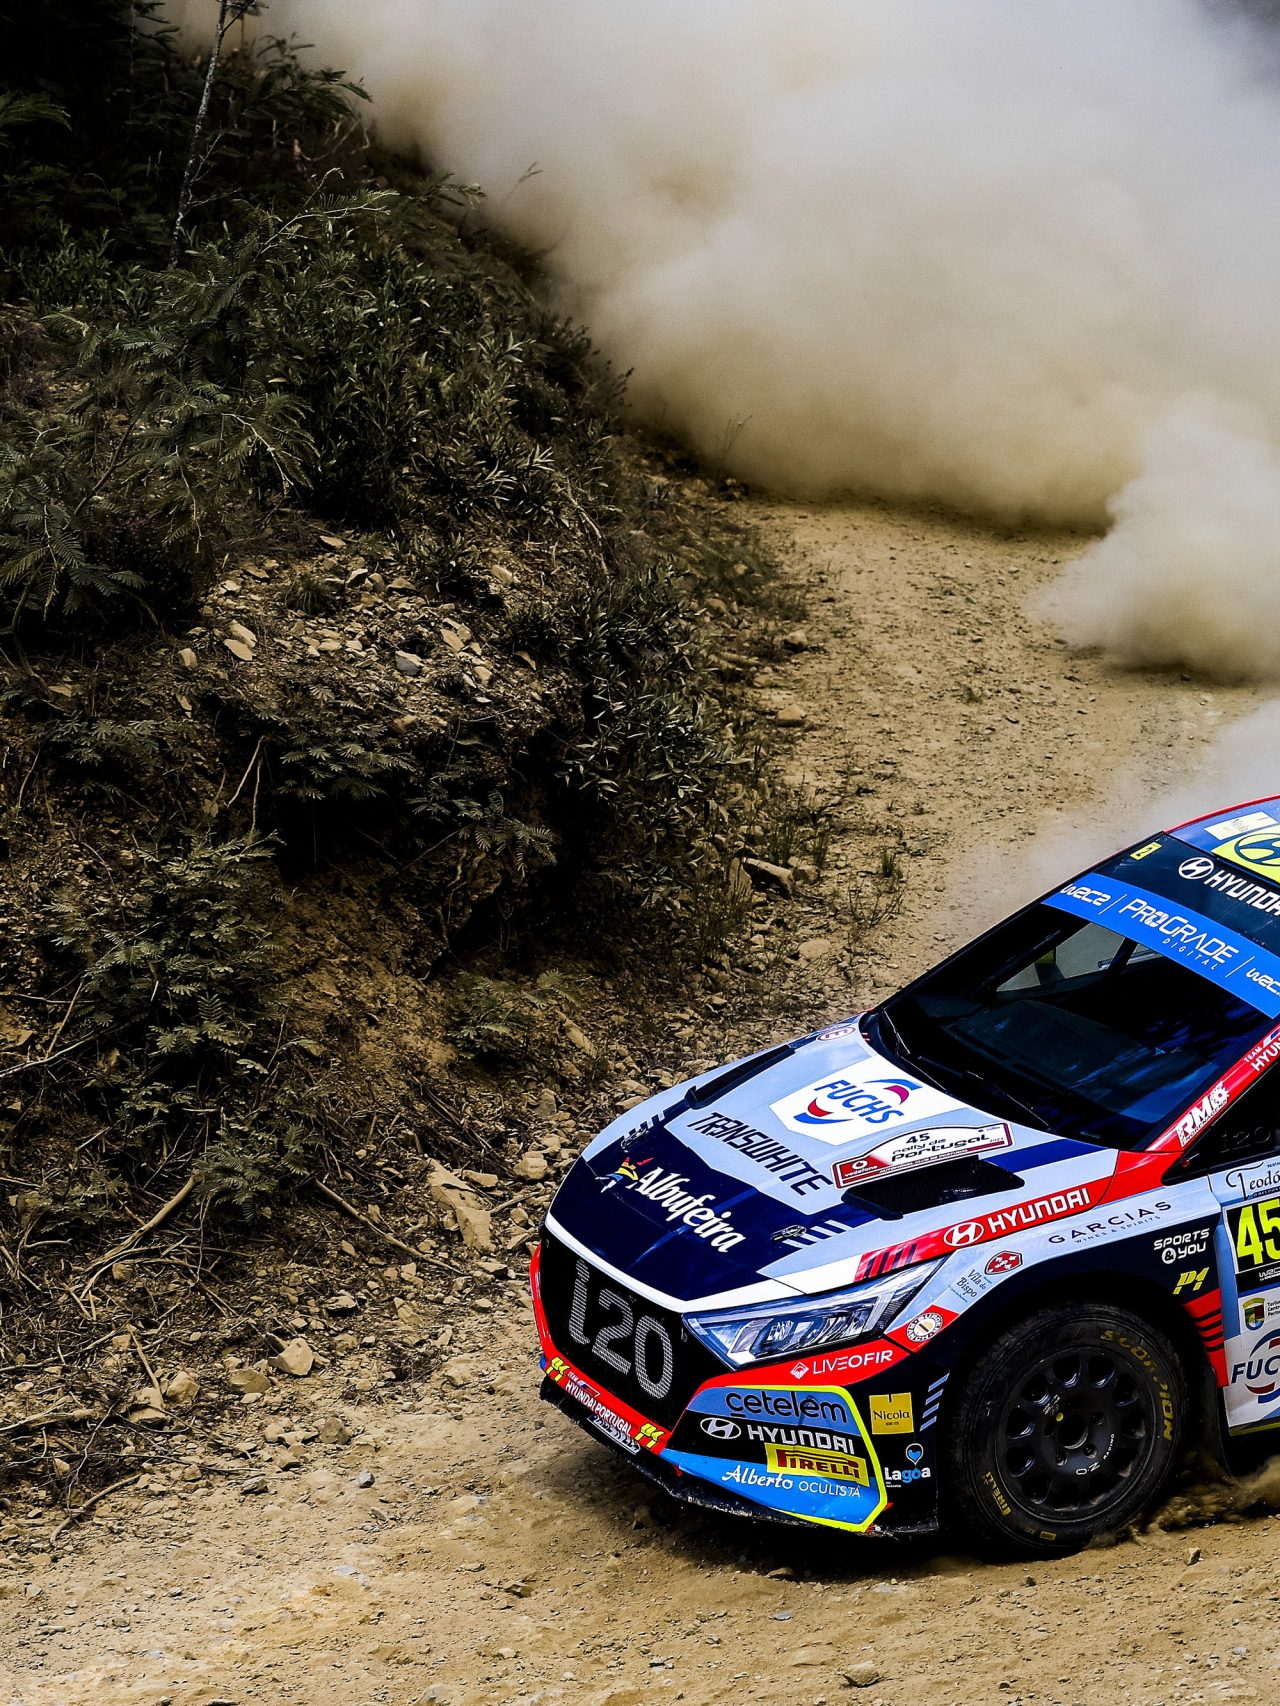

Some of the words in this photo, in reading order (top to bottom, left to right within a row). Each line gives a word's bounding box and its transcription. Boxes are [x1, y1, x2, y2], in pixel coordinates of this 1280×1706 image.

[1162, 937, 1219, 971] DIGITAL
[1243, 1046, 1264, 1063] TEAM
[813, 1079, 905, 1124] FUCHS
[891, 1133, 990, 1162] Portugal
[905, 1132, 931, 1144] 45
[844, 1165, 878, 1178] vodafone
[634, 1166, 747, 1253] Albufeira
[986, 1187, 1091, 1233] HYUNDAI
[1048, 1201, 1172, 1244] GARCIAS
[1153, 1227, 1210, 1251] SPORTS
[955, 1276, 978, 1298] Bispo
[966, 1269, 982, 1286] Vila
[567, 1257, 673, 1399] i20
[813, 1349, 894, 1375] LIVEOFIR
[565, 1380, 597, 1412] HYUNDAI
[594, 1403, 632, 1437] PORTUGAL
[725, 1390, 847, 1424] cetelem
[873, 1409, 910, 1421] Nicola
[747, 1425, 855, 1456] HYUNDAI
[775, 1449, 860, 1480] PIRELLI
[884, 1467, 931, 1483] Lagoa
[721, 1464, 794, 1491] Alberto
[798, 1480, 862, 1499] OCULISTA
